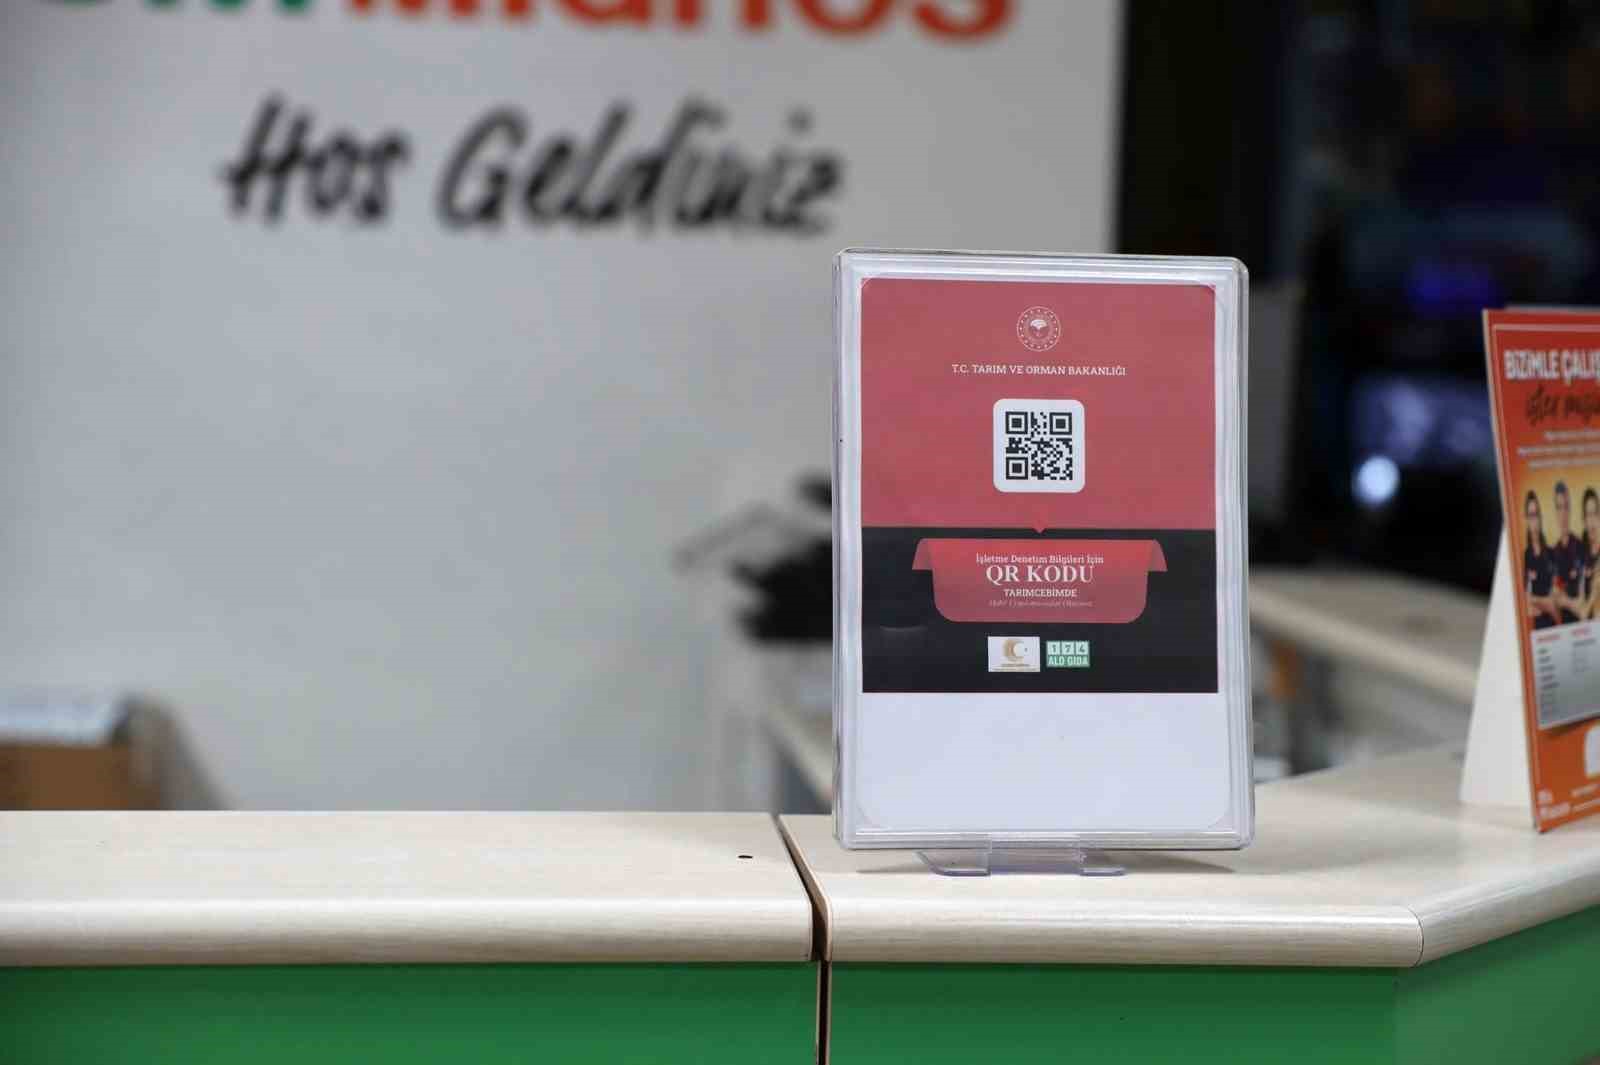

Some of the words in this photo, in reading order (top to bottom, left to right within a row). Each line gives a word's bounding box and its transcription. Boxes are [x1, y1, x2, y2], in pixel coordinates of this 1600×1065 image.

[952, 364, 969, 374] T.C.
[972, 364, 1006, 375] TARIM
[1009, 365, 1024, 375] VE
[1026, 366, 1066, 376] ORMAN
[1068, 365, 1126, 377] BAKANLIĞI
[986, 564, 1021, 586] QR
[1027, 564, 1095, 583] KODU
[1048, 656, 1065, 665] ALO
